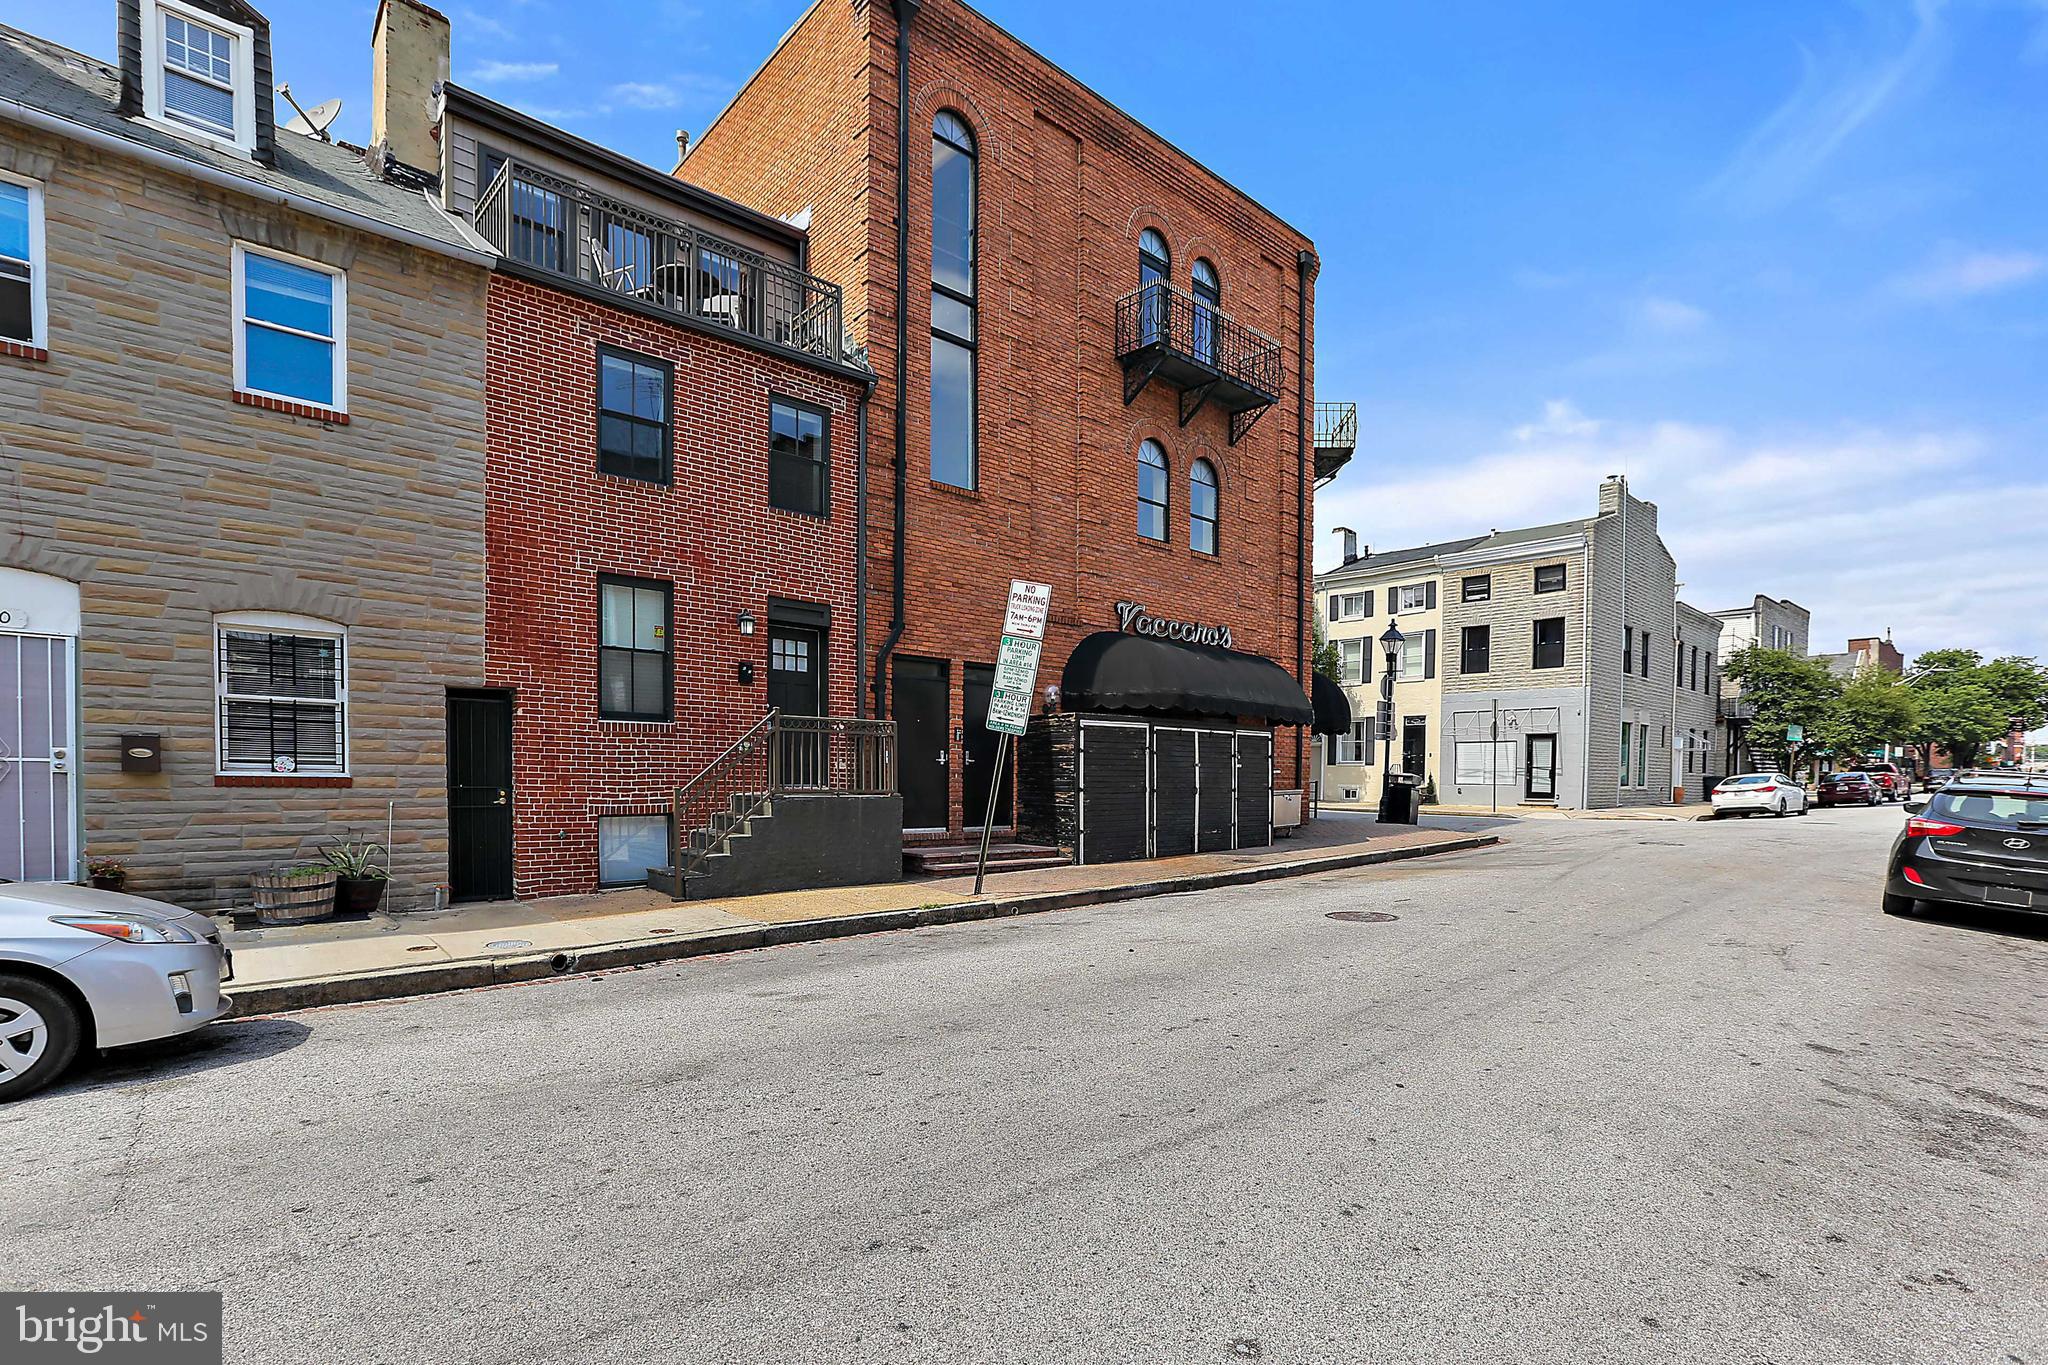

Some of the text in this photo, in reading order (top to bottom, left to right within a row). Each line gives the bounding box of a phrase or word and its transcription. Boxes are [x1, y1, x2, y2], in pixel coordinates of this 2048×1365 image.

[1025, 585, 1036, 594] NO
[1012, 593, 1046, 606] PARKING
[1010, 611, 1042, 624] 7AM-6PM
[1116, 600, 1233, 649] Vaccaro's
[1014, 640, 1037, 650] HOUR
[1007, 646, 1033, 656] PARKING
[1005, 693, 1027, 703] HOUR
